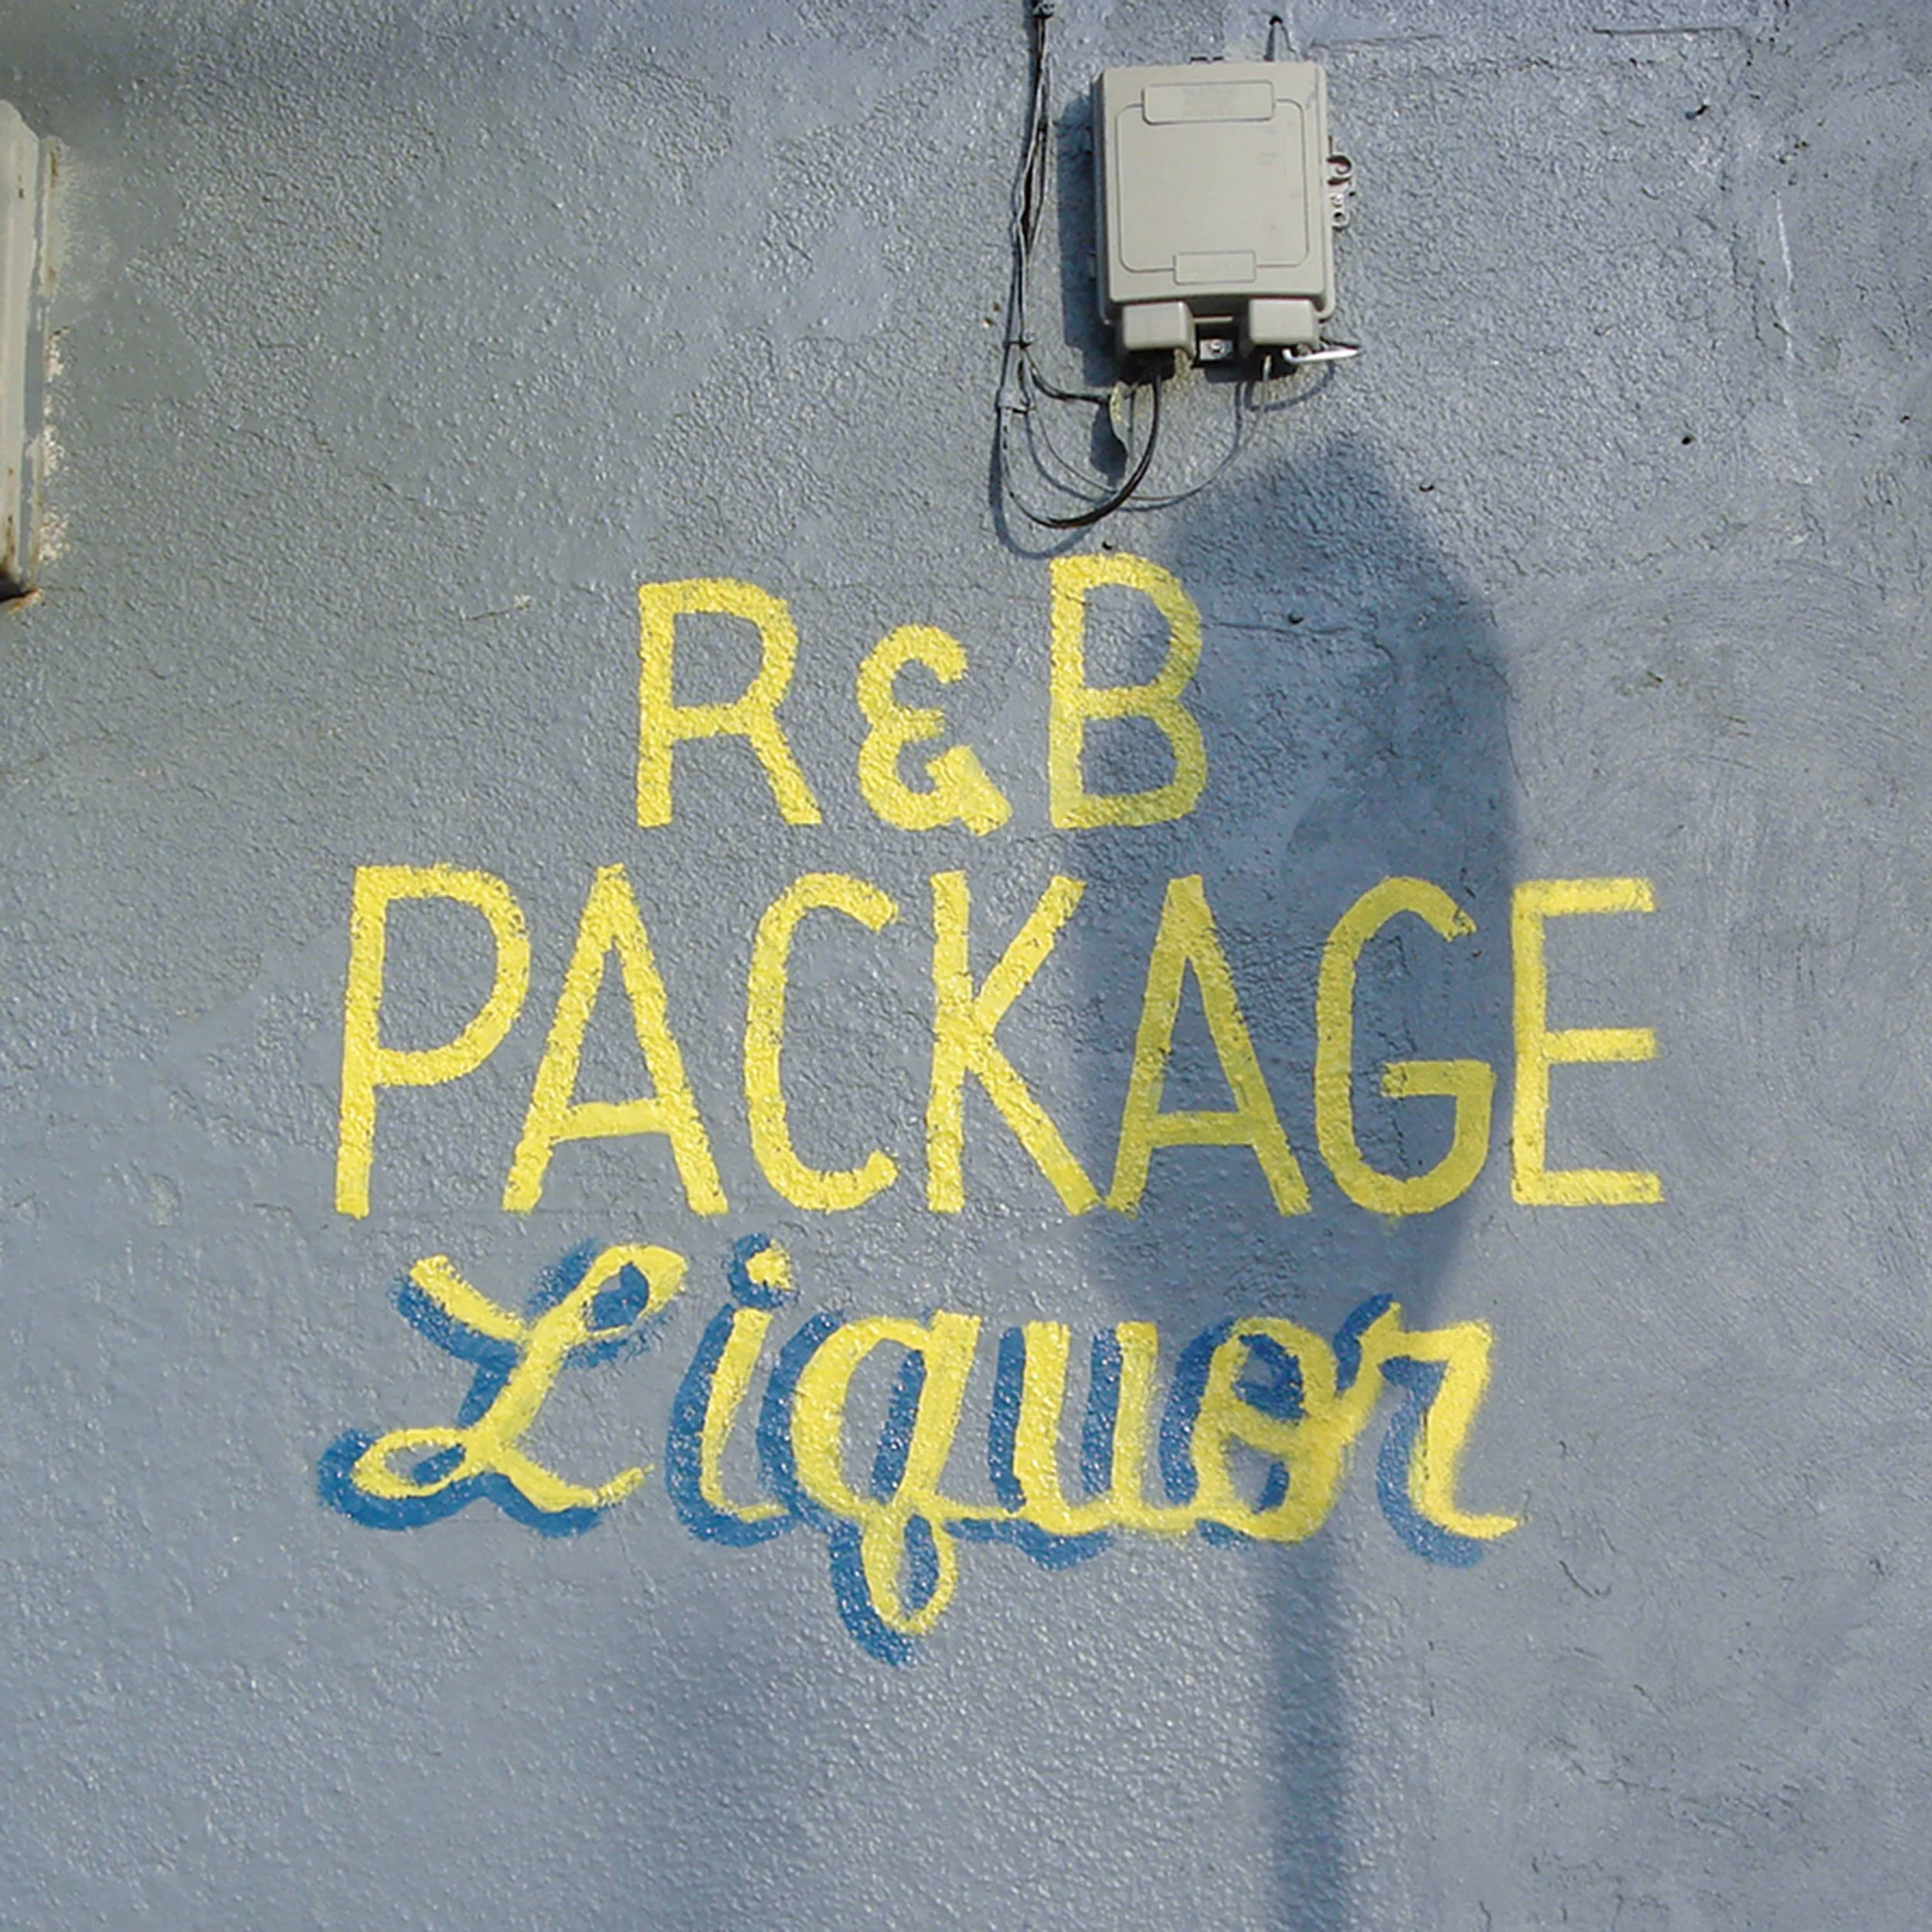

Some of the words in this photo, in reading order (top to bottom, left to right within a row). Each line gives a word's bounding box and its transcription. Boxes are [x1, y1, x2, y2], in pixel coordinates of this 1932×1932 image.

[635, 554, 1206, 835] R&B
[334, 863, 1663, 1219] PACKAGE
[318, 1235, 1519, 1665] Liquor
